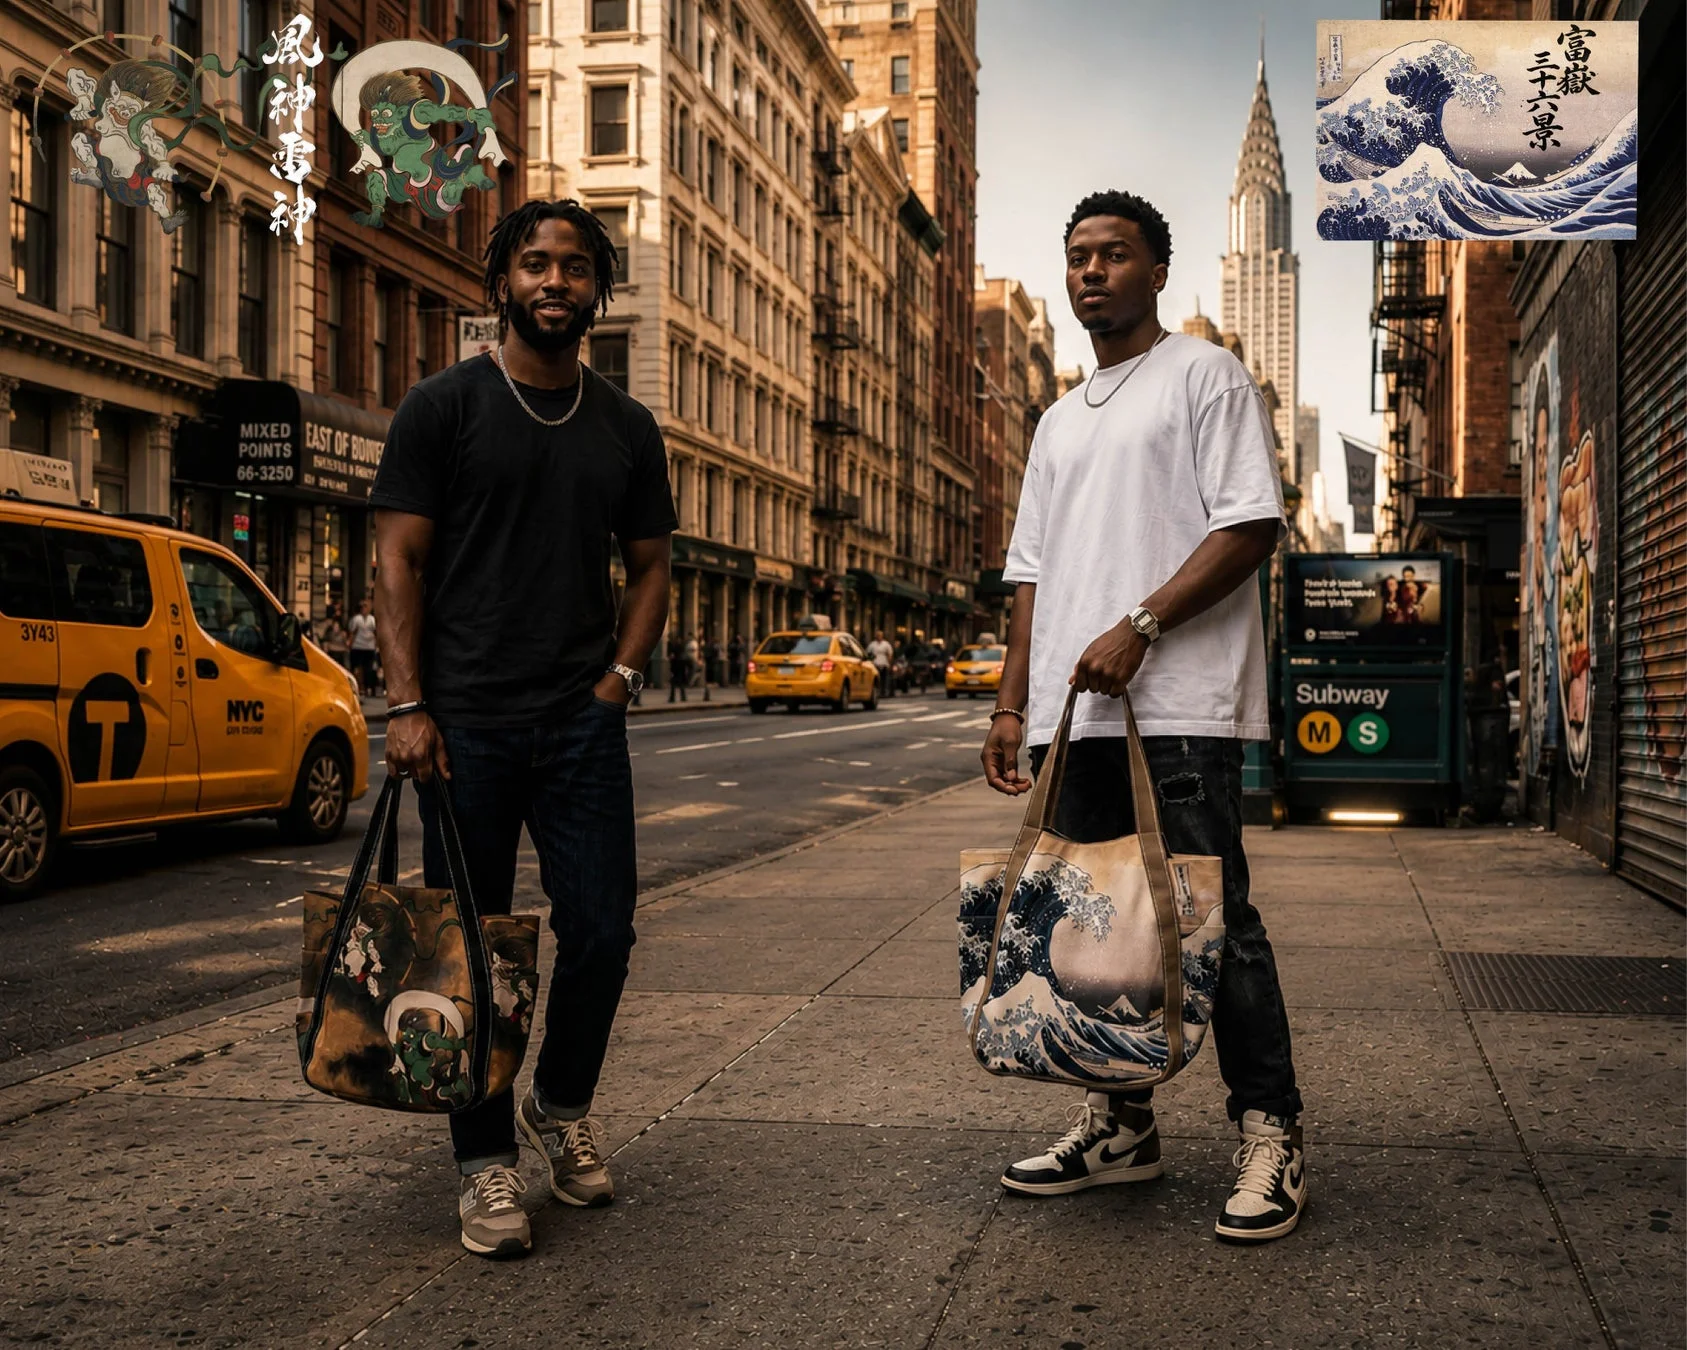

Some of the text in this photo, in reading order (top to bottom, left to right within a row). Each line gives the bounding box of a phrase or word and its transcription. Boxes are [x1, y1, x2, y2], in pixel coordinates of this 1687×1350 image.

[240, 423, 291, 439] MIXED
[305, 421, 333, 452] EAST
[335, 430, 350, 456] OF
[238, 442, 292, 458] POINTS
[21, 623, 55, 642] 3Y43
[1296, 683, 1390, 710] Subway
[227, 700, 264, 722] NYC
[85, 700, 130, 783] T
[1308, 720, 1379, 746] M S
